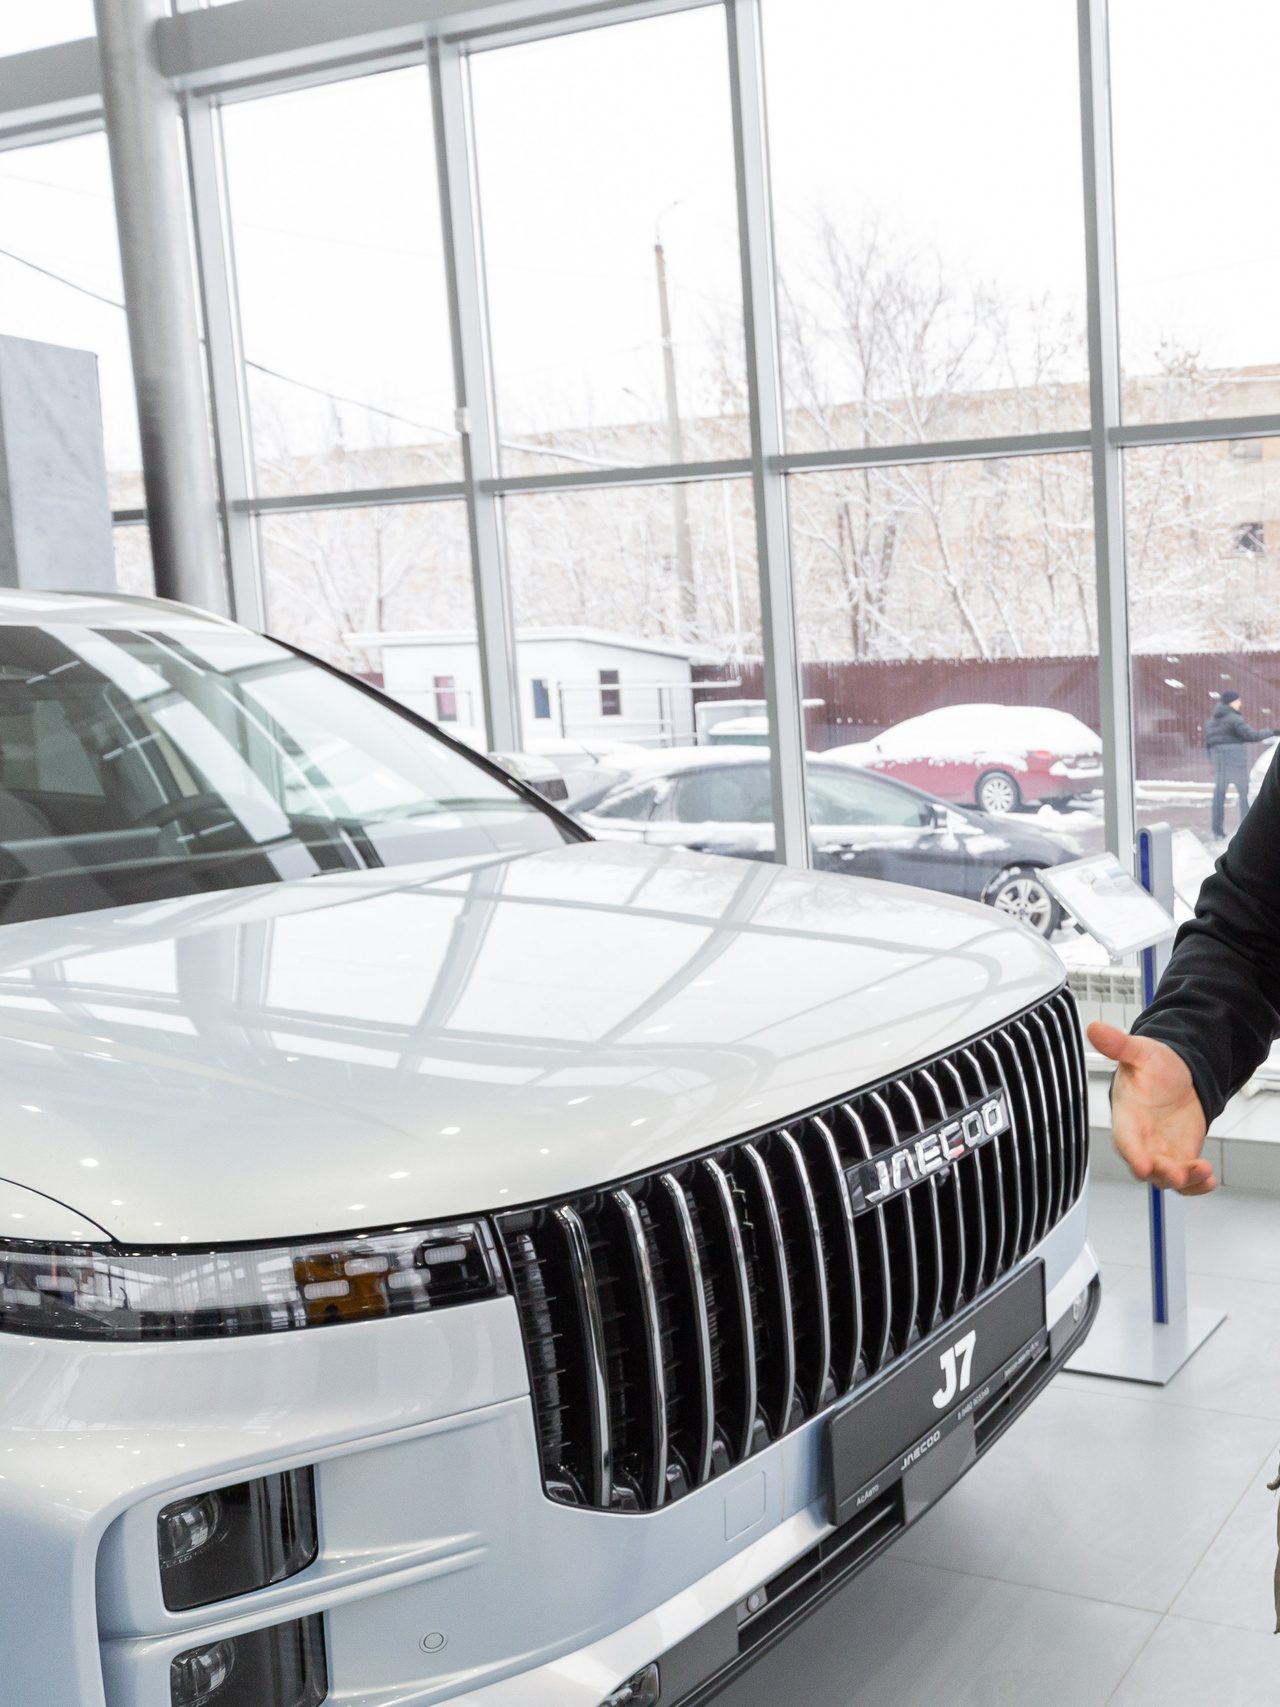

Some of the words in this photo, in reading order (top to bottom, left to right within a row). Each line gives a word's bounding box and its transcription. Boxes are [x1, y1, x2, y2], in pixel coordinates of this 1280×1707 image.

[865, 1098, 1003, 1203] JAECOO
[932, 1330, 976, 1409] J7
[900, 1430, 941, 1471] JAECOO
